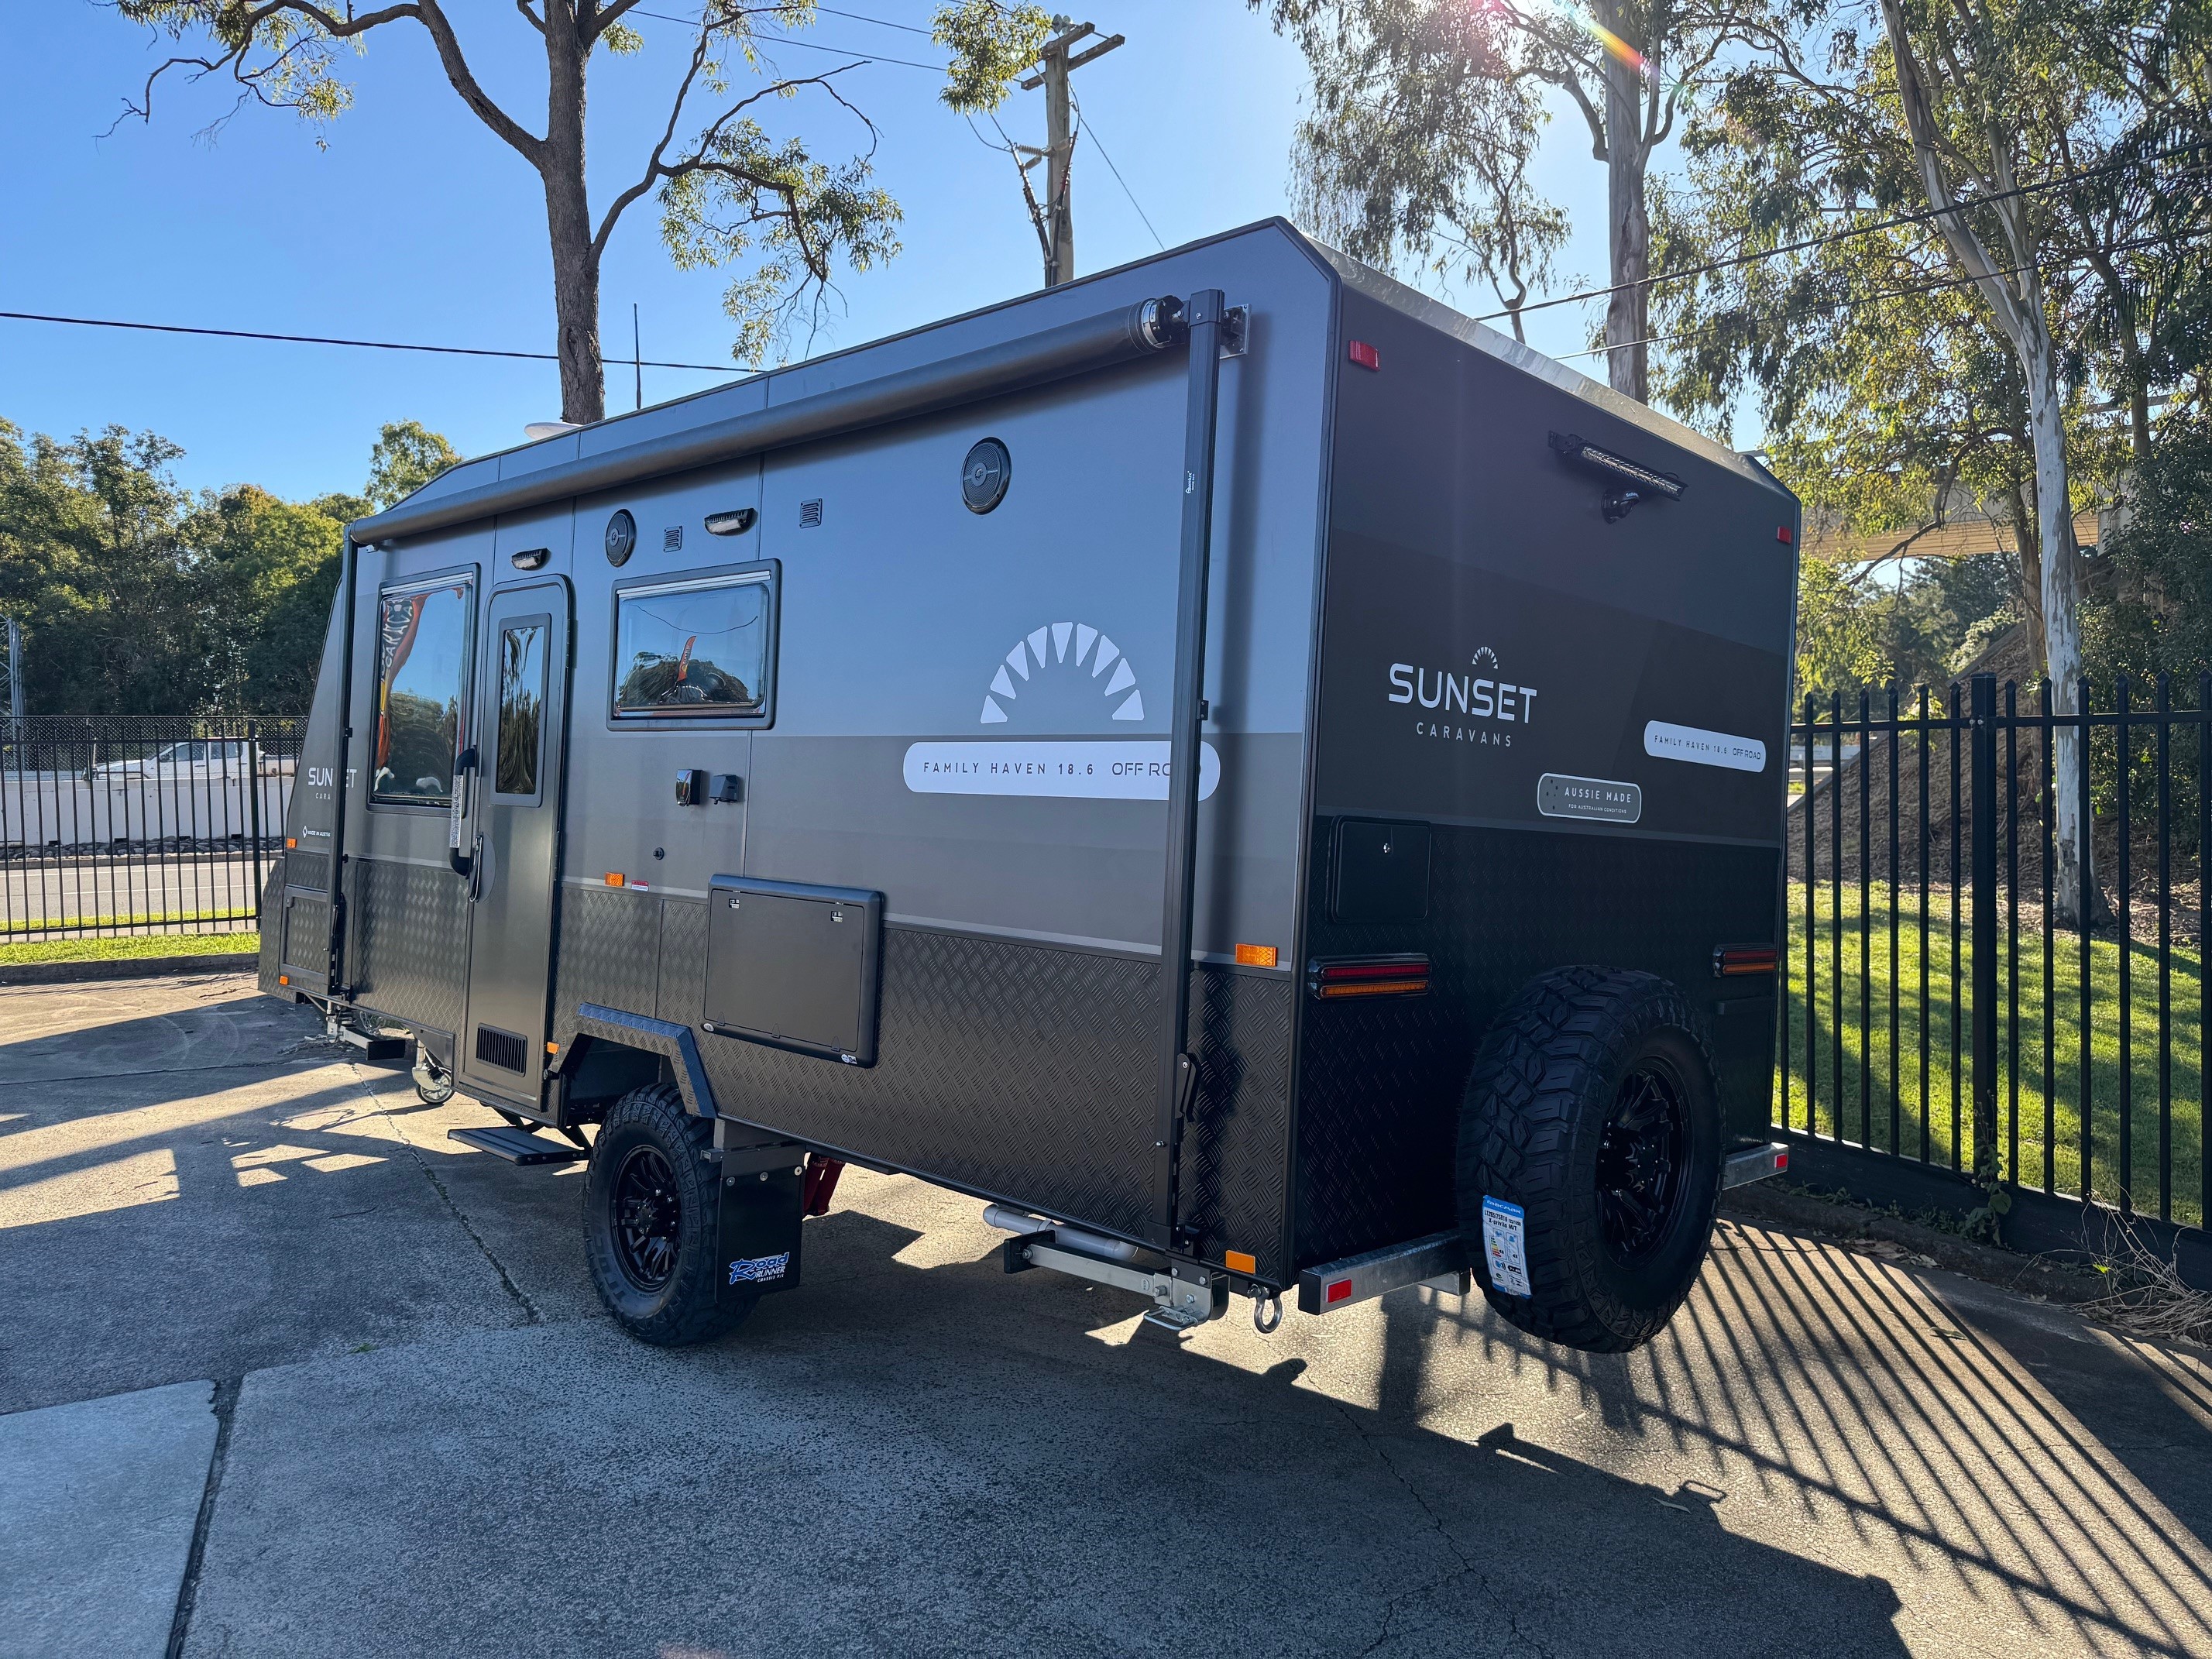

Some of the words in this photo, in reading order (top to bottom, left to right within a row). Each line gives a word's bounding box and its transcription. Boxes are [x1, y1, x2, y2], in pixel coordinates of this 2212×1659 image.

[1389, 663, 1537, 723] SUNSET
[1417, 722, 1511, 747] CARAVANS
[1654, 735, 1681, 747] FAMILY
[1686, 740, 1709, 751] HAVEN
[1713, 745, 1727, 754] 18.6
[1733, 747, 1744, 757] OFF
[1744, 749, 1761, 760] ROAD
[923, 762, 979, 773] FAMILY
[991, 763, 1046, 775] HAVEN
[1058, 763, 1093, 775] 18.6
[1111, 762, 1144, 776] OFF
[1565, 787, 1600, 799] AUSSIE
[1606, 792, 1631, 802] MADE
[729, 1252, 790, 1285] Road
[755, 1266, 786, 1278] RUNNER
